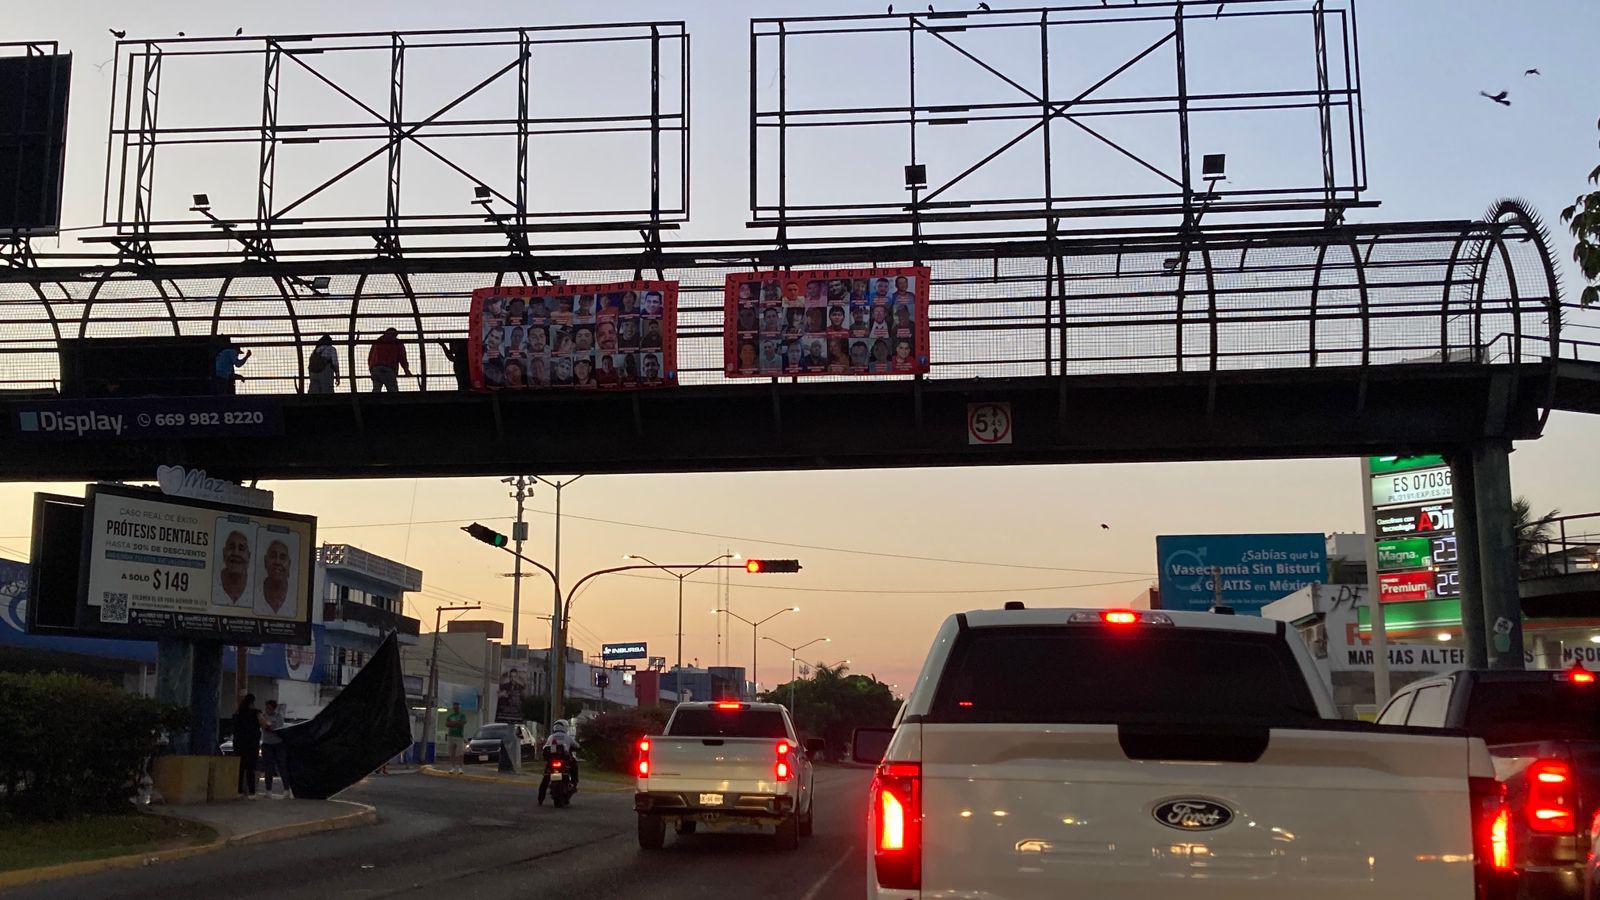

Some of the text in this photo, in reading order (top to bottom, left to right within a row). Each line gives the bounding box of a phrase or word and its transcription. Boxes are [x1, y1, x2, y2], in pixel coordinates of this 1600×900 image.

[155, 413, 185, 426] 669
[189, 412, 220, 426] 982
[223, 411, 264, 425] 8220
[1393, 476, 1408, 492] ES
[120, 508, 141, 517] CASO
[143, 511, 162, 520] REAL
[106, 519, 209, 546] PRÓTESIS DENTALES
[105, 540, 207, 558] HASTA 50% DE DESCUENTO
[1241, 549, 1319, 563] ¿Sabías que la
[1378, 551, 1416, 563] Magna
[1171, 563, 1320, 575] Vasectomía Sin Bisturí
[129, 573, 150, 582] SOLO
[153, 568, 190, 592] $149
[1254, 583, 1267, 591] en
[1381, 582, 1428, 594] Premium
[1168, 803, 1220, 826] Ford
